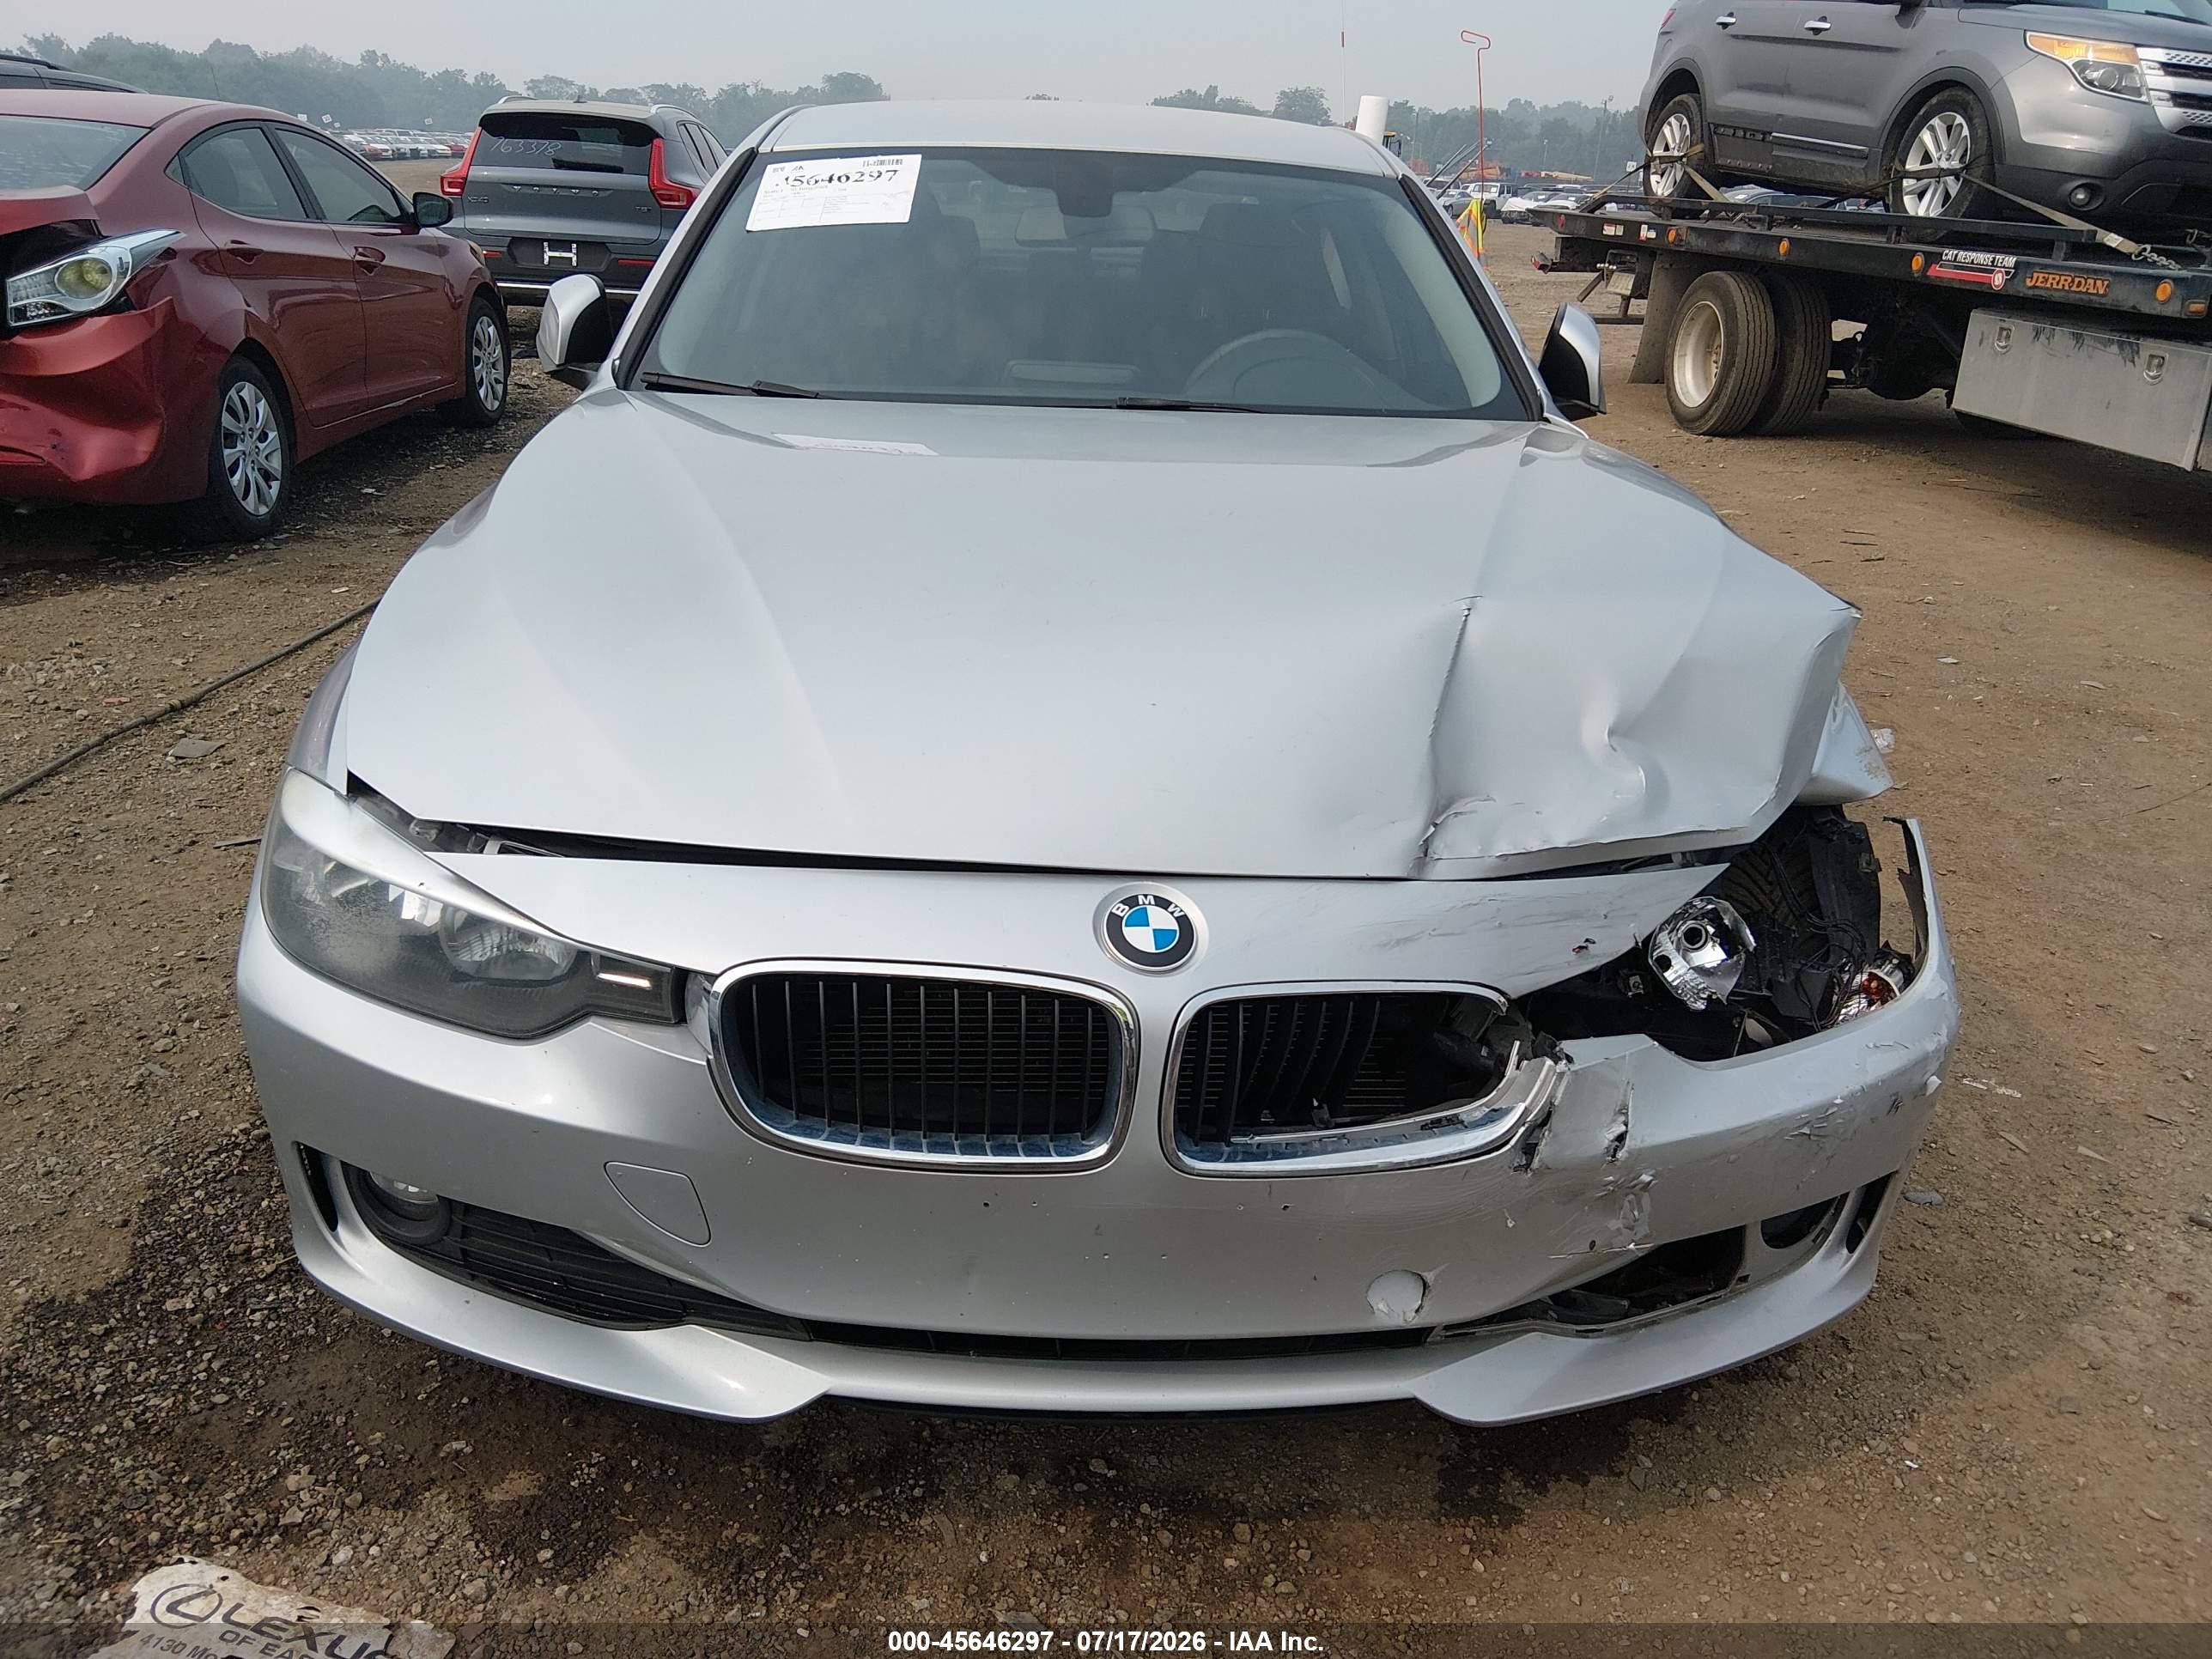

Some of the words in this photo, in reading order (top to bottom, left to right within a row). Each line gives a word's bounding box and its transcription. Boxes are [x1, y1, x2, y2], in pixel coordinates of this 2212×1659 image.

[490, 136, 562, 155] 763378
[1942, 250, 1959, 262] CAT
[1958, 252, 1995, 266] RESPONSE
[1994, 255, 2017, 268] TEAM
[1111, 895, 1185, 918] BMW
[140, 1634, 187, 1655] 4130
[219, 1630, 257, 1646] OF
